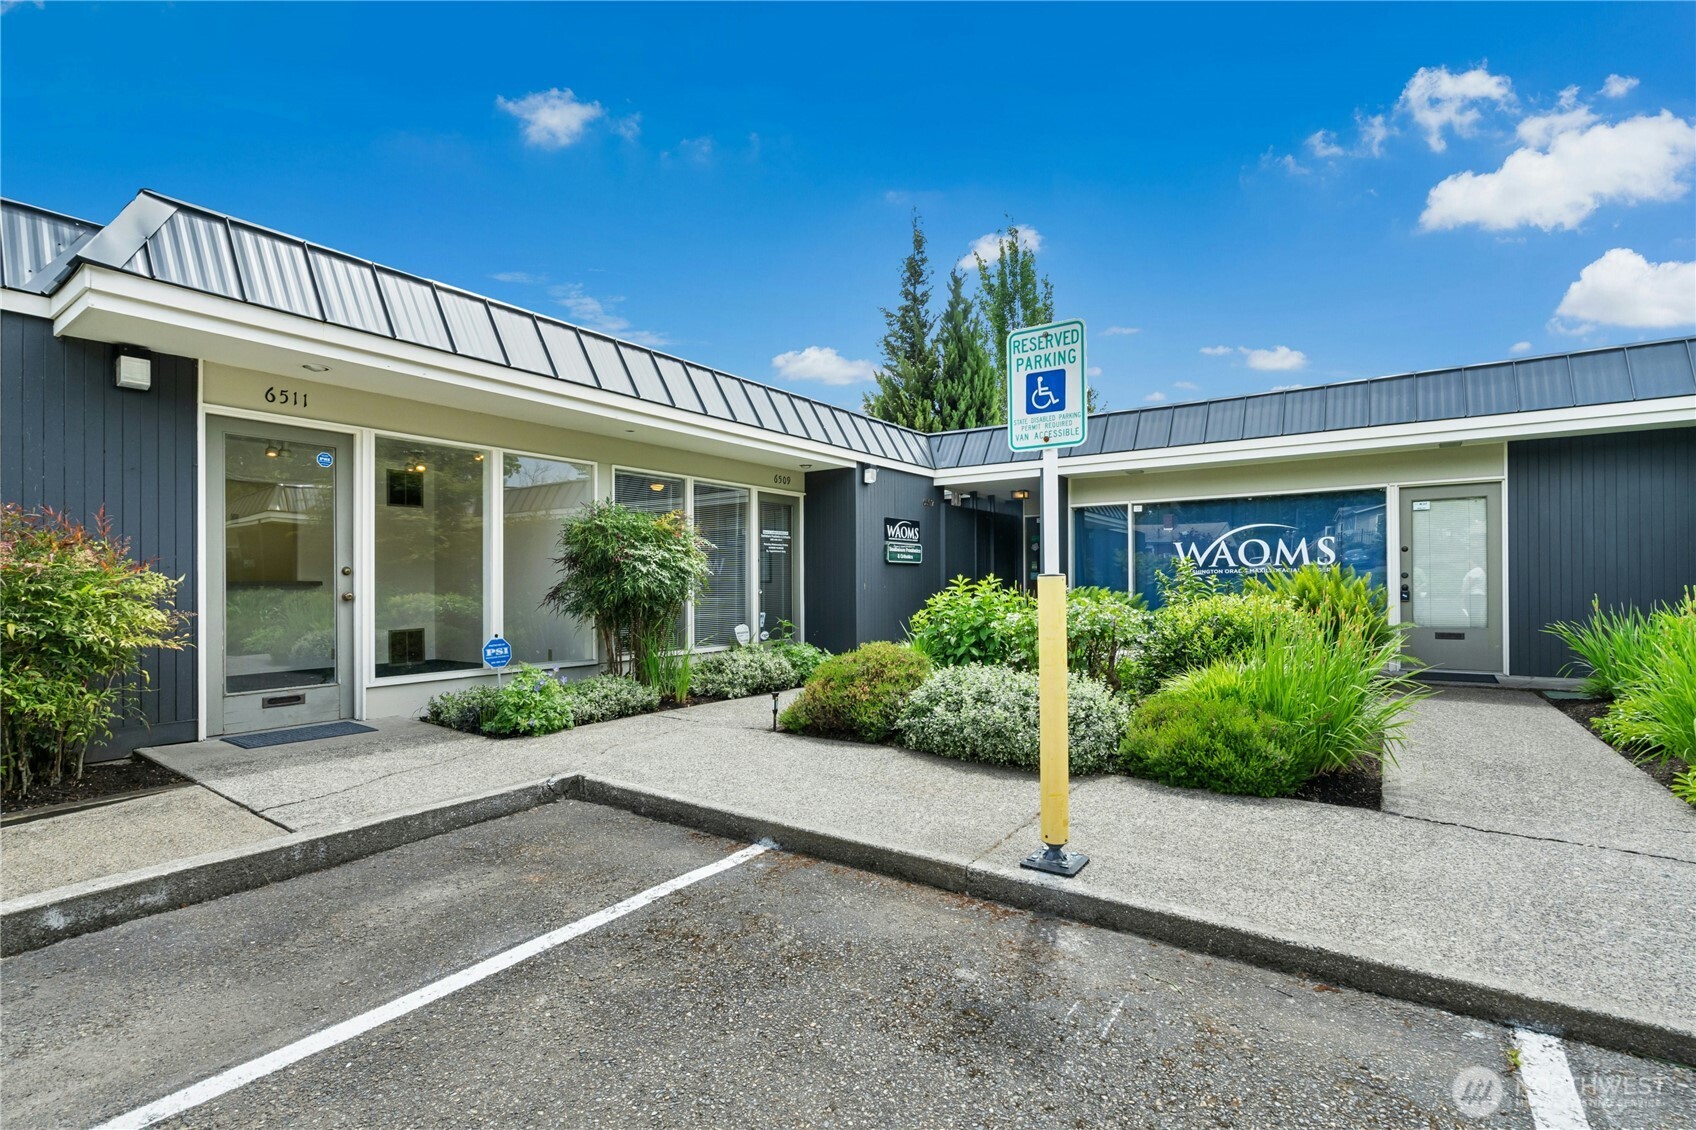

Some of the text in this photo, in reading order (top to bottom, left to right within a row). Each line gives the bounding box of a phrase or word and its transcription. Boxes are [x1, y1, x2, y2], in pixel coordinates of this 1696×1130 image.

[1013, 329, 1079, 354] RESERVED
[1017, 349, 1076, 372] PARKING
[265, 386, 307, 408] 6511
[1031, 415, 1056, 424] DISABLED
[1058, 411, 1082, 420] PARKING
[1021, 420, 1073, 432] PERMIT REQUIRED
[1015, 427, 1080, 442] VAN ACCESSIBLE
[773, 474, 791, 485] 6509
[886, 523, 919, 540] WAOMS
[1173, 535, 1336, 568] WAOMS
[485, 647, 509, 656] PSI
